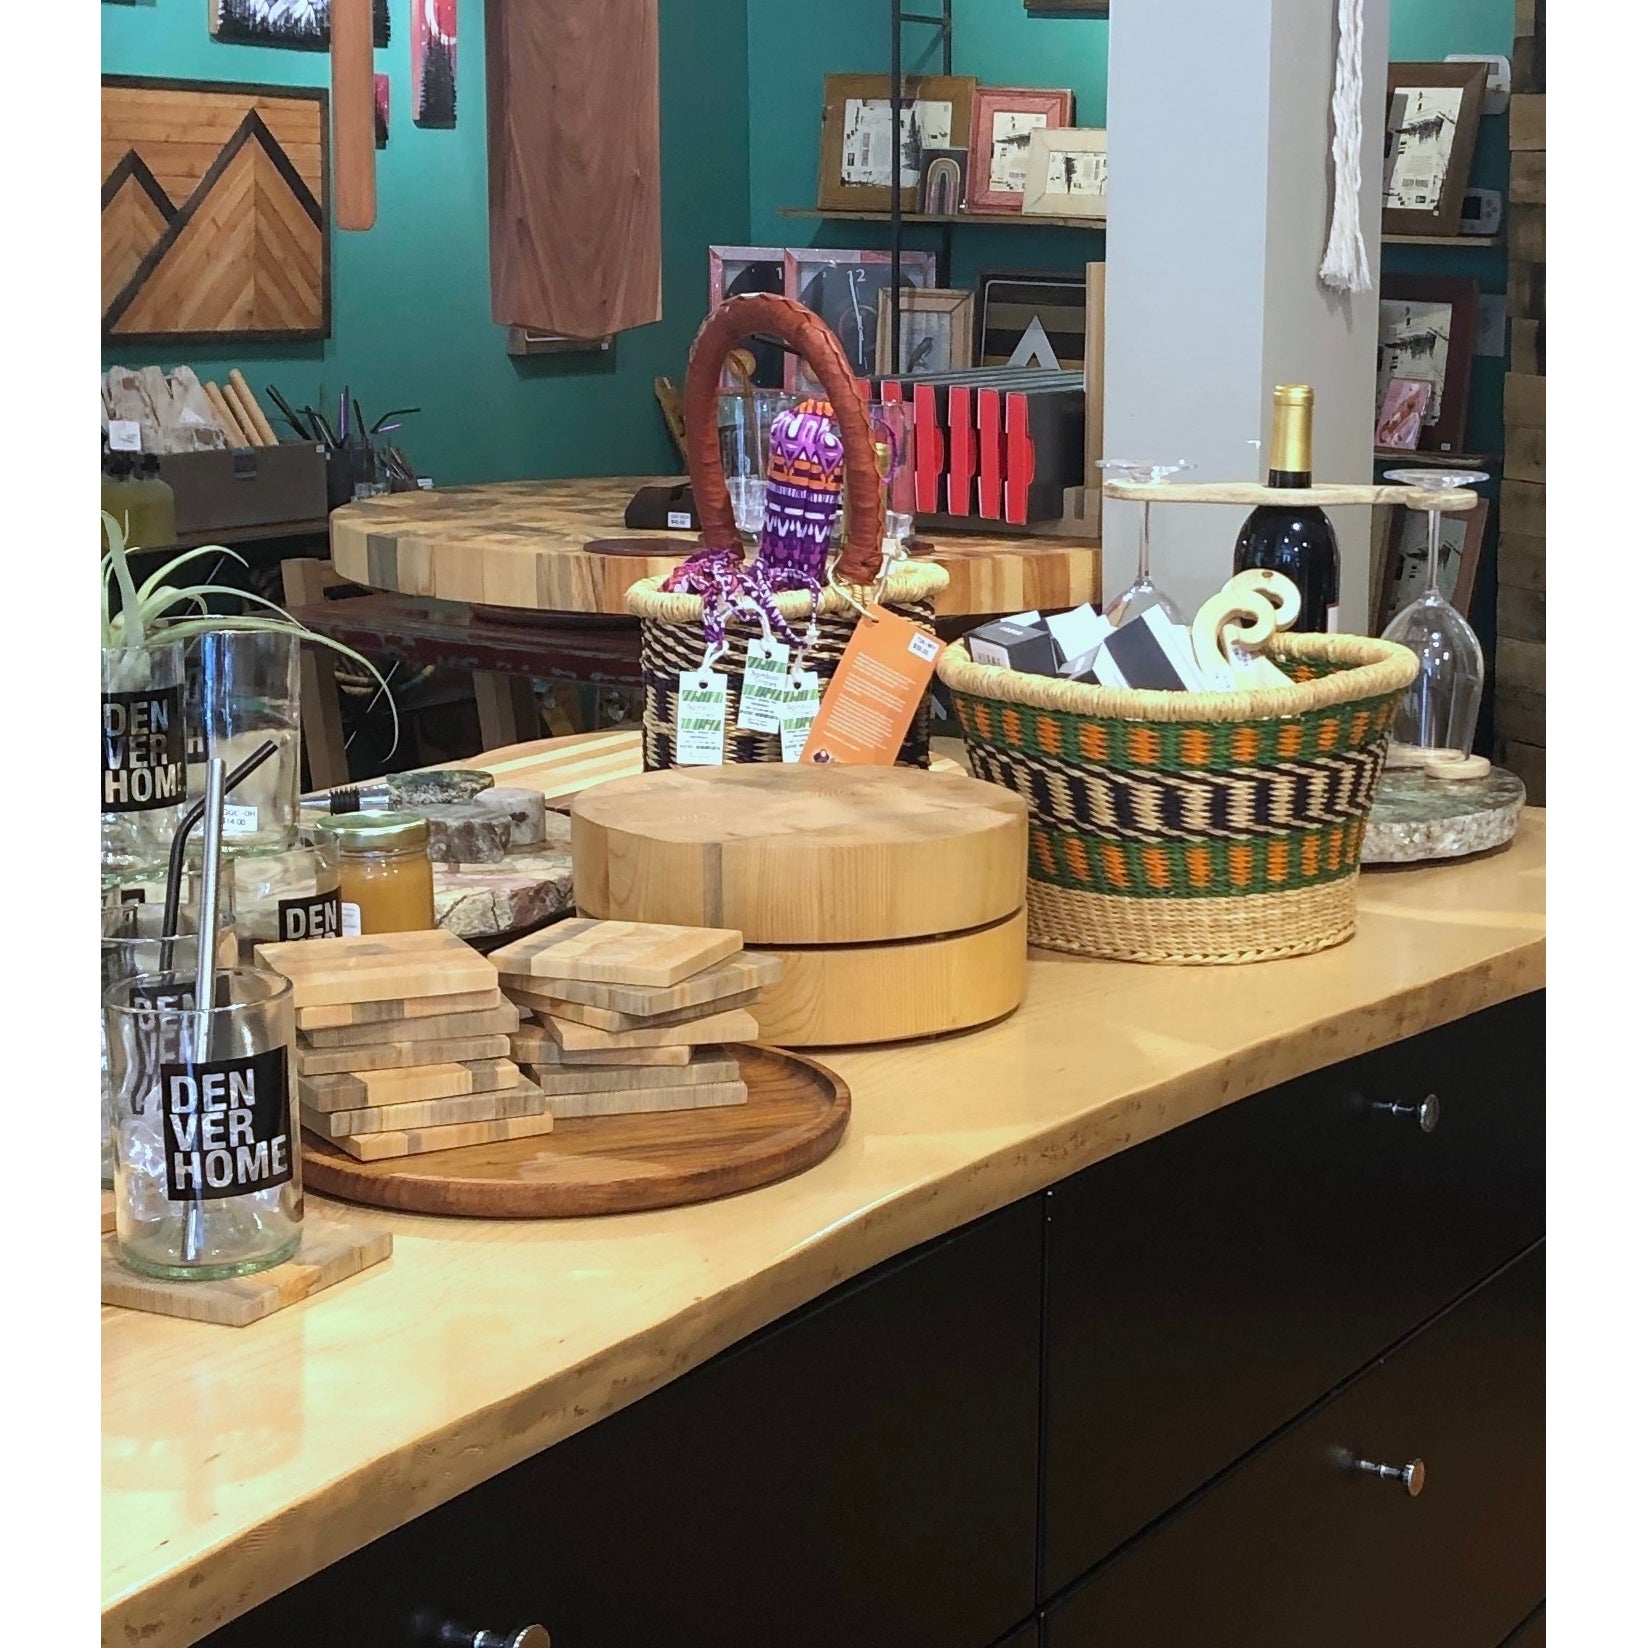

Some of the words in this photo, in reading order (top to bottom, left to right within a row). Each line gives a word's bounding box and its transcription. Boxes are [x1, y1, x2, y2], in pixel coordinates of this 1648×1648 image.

[846, 269, 867, 283] 12
[103, 699, 169, 736] DEN
[104, 734, 168, 770] VER
[286, 900, 337, 939] DEN
[169, 1068, 256, 1114] DEN
[169, 1108, 255, 1152] VER
[173, 1134, 288, 1190] HOME
